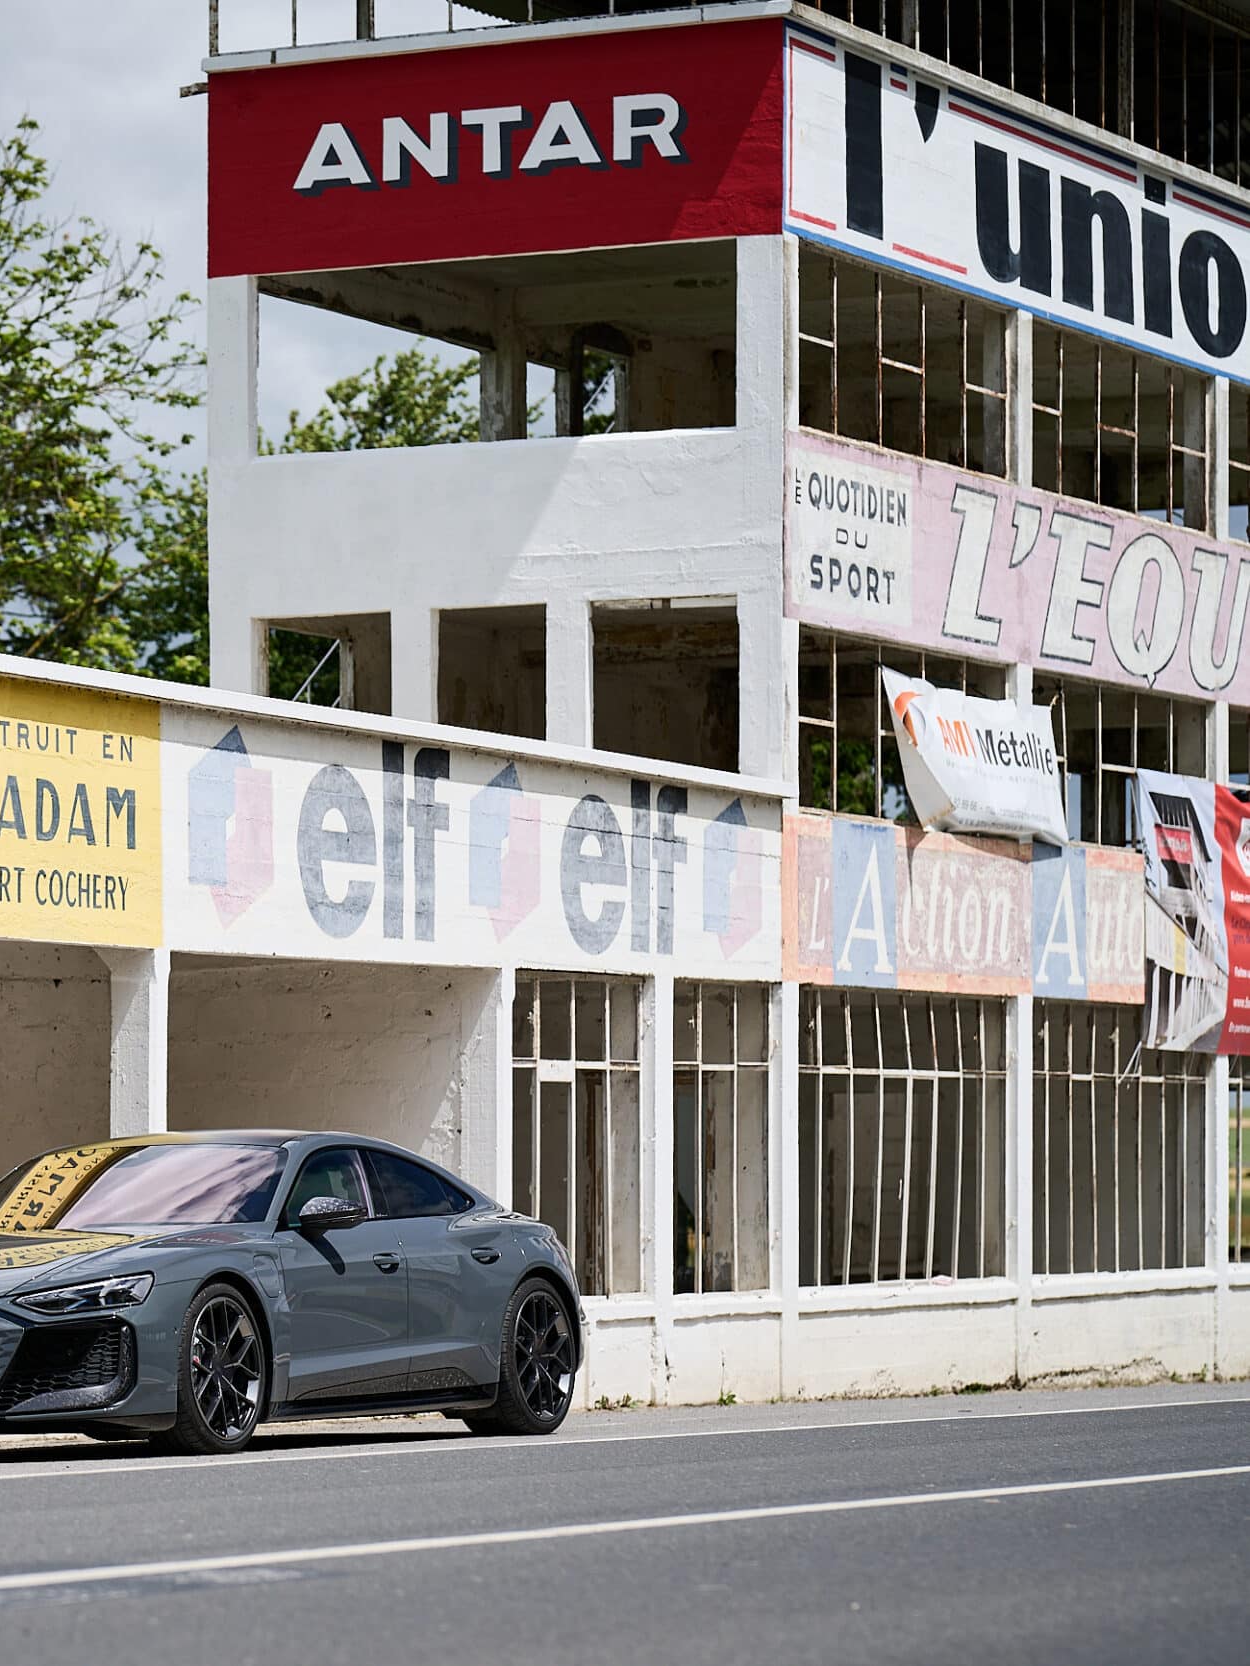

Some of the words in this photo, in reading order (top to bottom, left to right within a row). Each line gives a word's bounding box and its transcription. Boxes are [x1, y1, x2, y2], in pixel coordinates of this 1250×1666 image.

[292, 92, 689, 197] ANTAR
[794, 466, 802, 505] LE
[807, 471, 907, 528] QUOTIDIEN
[835, 527, 868, 549] DU
[810, 553, 895, 605] SPORT
[102, 734, 134, 763] EN
[296, 740, 450, 942] elf
[560, 778, 688, 956] elf
[35, 868, 130, 912] COCHERY
